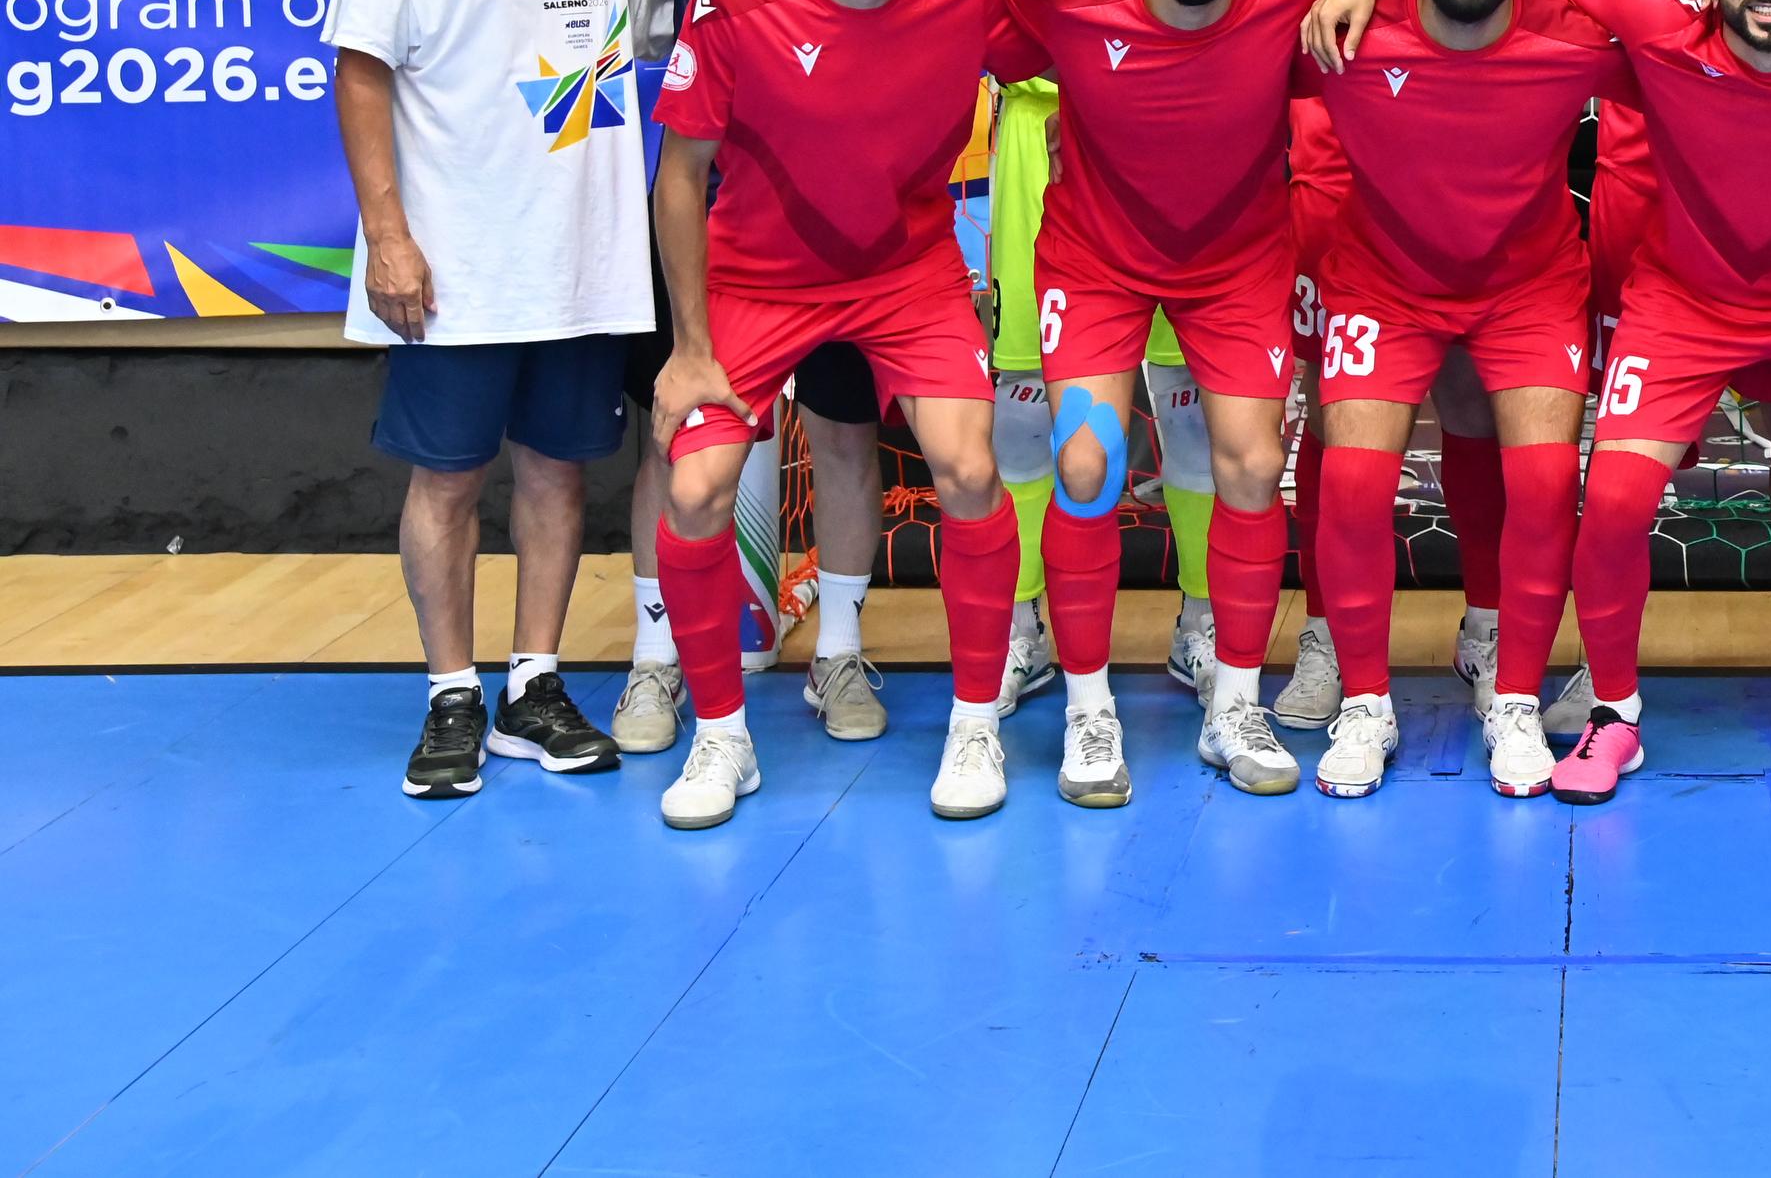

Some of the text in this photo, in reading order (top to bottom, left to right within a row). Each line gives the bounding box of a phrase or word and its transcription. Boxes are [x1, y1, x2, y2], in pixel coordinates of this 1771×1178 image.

[7, 46, 337, 116] g2026.e
[1040, 288, 1067, 354] 6
[1323, 314, 1380, 379] 53
[1597, 355, 1651, 419] 15
